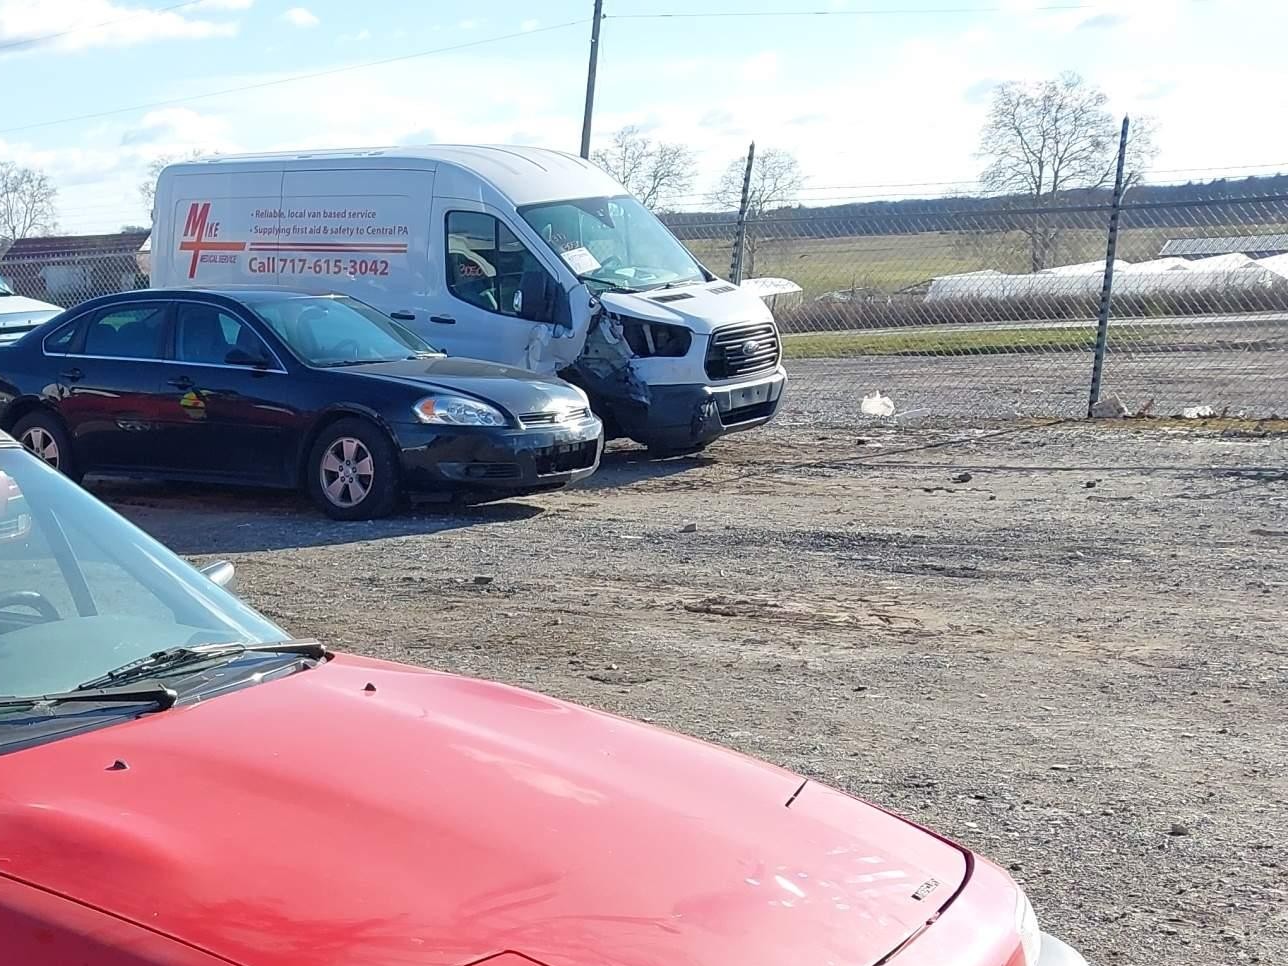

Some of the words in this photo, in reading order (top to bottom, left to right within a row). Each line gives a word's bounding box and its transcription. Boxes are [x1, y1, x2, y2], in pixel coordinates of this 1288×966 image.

[255, 209, 286, 220] Reliable,
[287, 209, 306, 219] local
[307, 210, 321, 219] van
[323, 209, 346, 219] based
[348, 210, 377, 219] service
[254, 225, 291, 237] Supplying
[292, 225, 308, 235] first
[309, 225, 321, 235] aid
[322, 226, 329, 235] &
[330, 225, 356, 237] safety
[356, 227, 364, 236] to
[366, 225, 396, 236] Central
[397, 226, 409, 236] PA
[249, 256, 276, 273] Call
[279, 258, 389, 276] 717-615-3042
